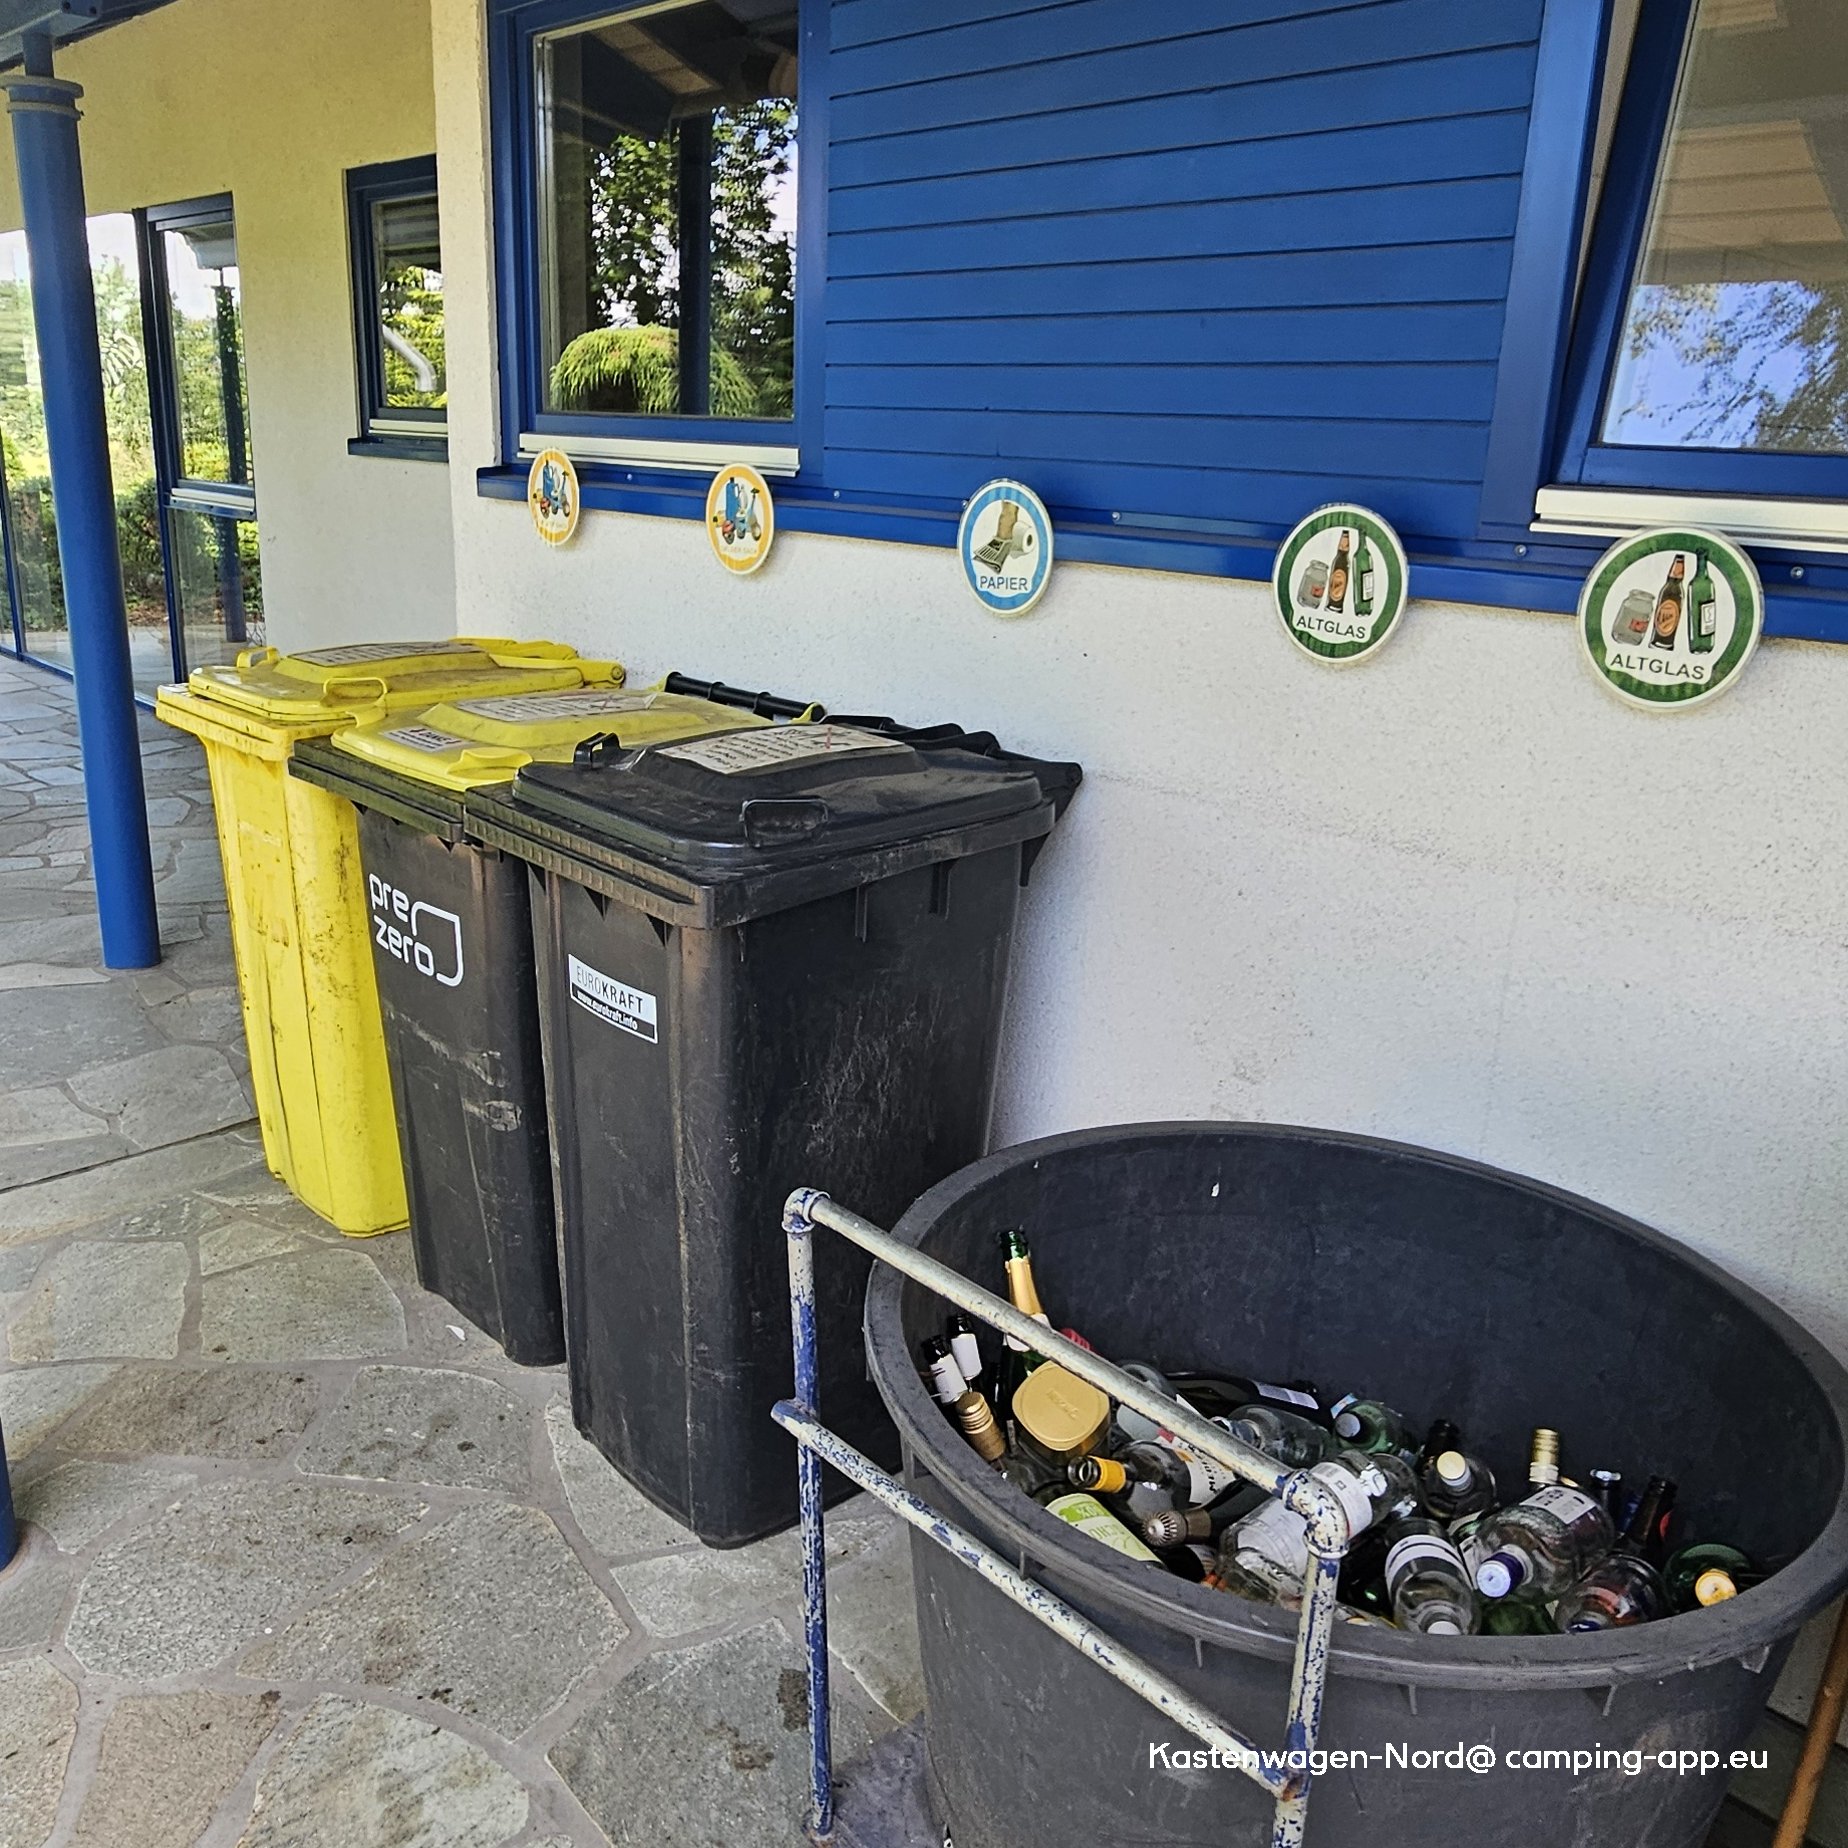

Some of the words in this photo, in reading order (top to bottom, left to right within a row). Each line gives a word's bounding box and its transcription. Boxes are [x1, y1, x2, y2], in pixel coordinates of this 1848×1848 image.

[979, 575, 1029, 591] PAPIER
[1295, 615, 1367, 640] ALTGLAS
[1610, 653, 1705, 681] ALTGLAS
[368, 873, 410, 923] pre
[373, 914, 435, 976] zero
[576, 965, 644, 1015] EUROKRAFT
